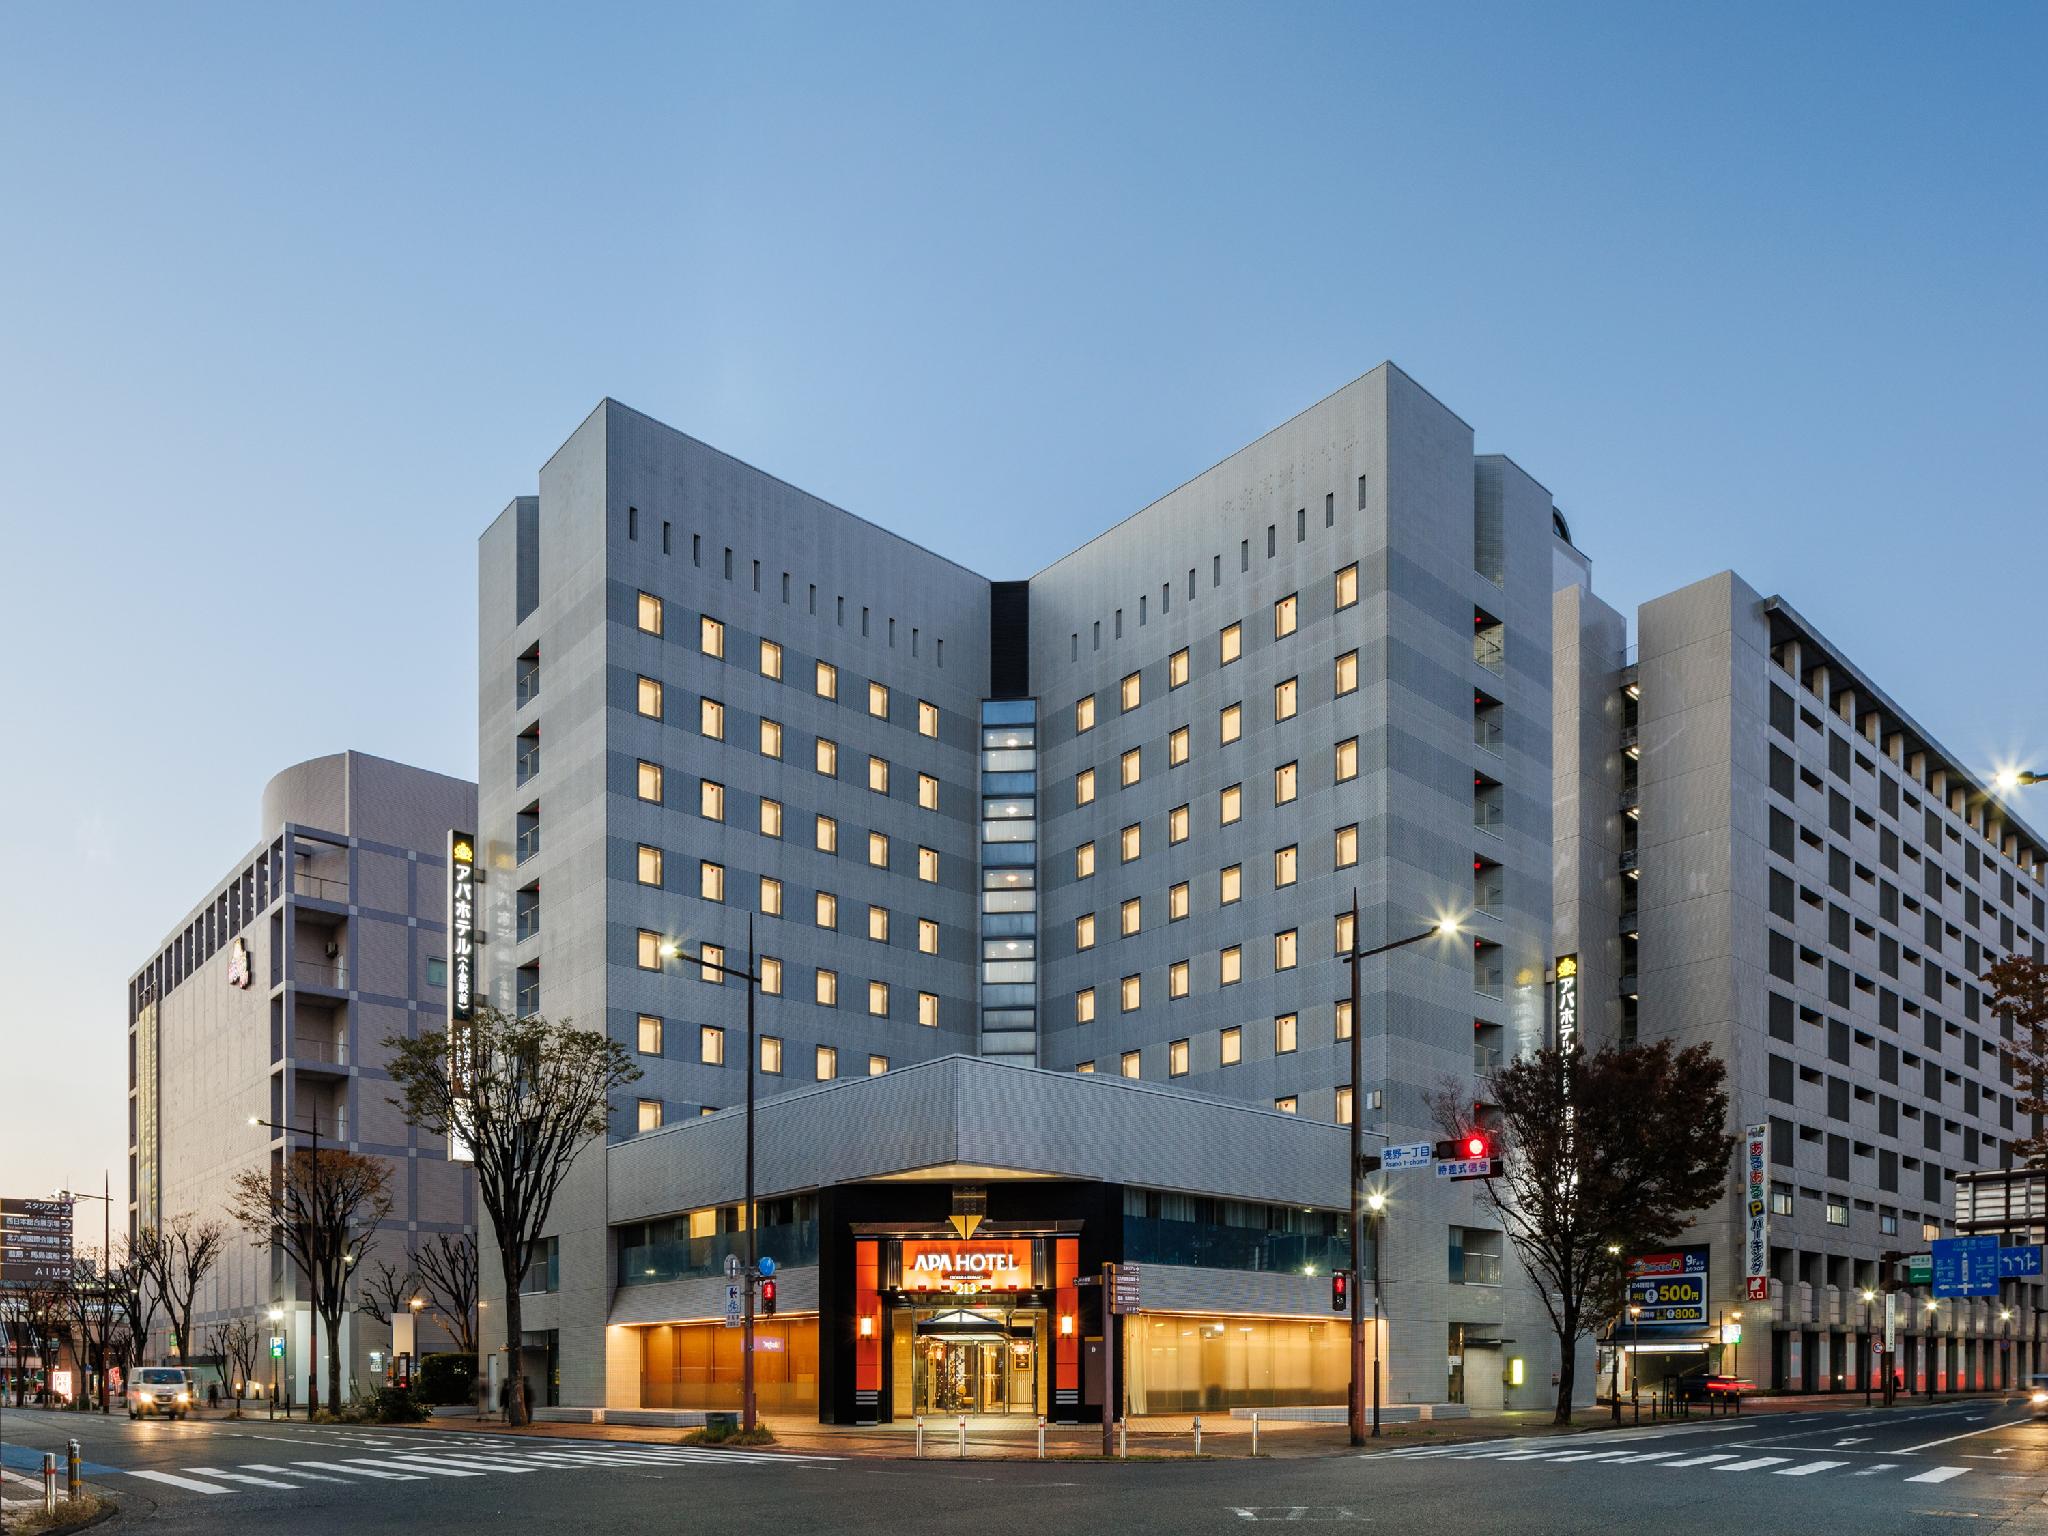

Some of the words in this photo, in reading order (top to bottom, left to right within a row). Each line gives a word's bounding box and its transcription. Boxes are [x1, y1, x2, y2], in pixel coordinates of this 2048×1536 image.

[1383, 1145, 1430, 1161] 浅野一丁目
[1437, 1161, 1489, 1176] 時差式信号
[25, 1201, 60, 1211] スタジアム
[914, 1253, 953, 1271] APA
[955, 1253, 1020, 1271] HOTEL
[956, 1282, 976, 1295] 213
[1659, 1284, 1699, 1302] 500円
[1749, 1291, 1764, 1300] 入口
